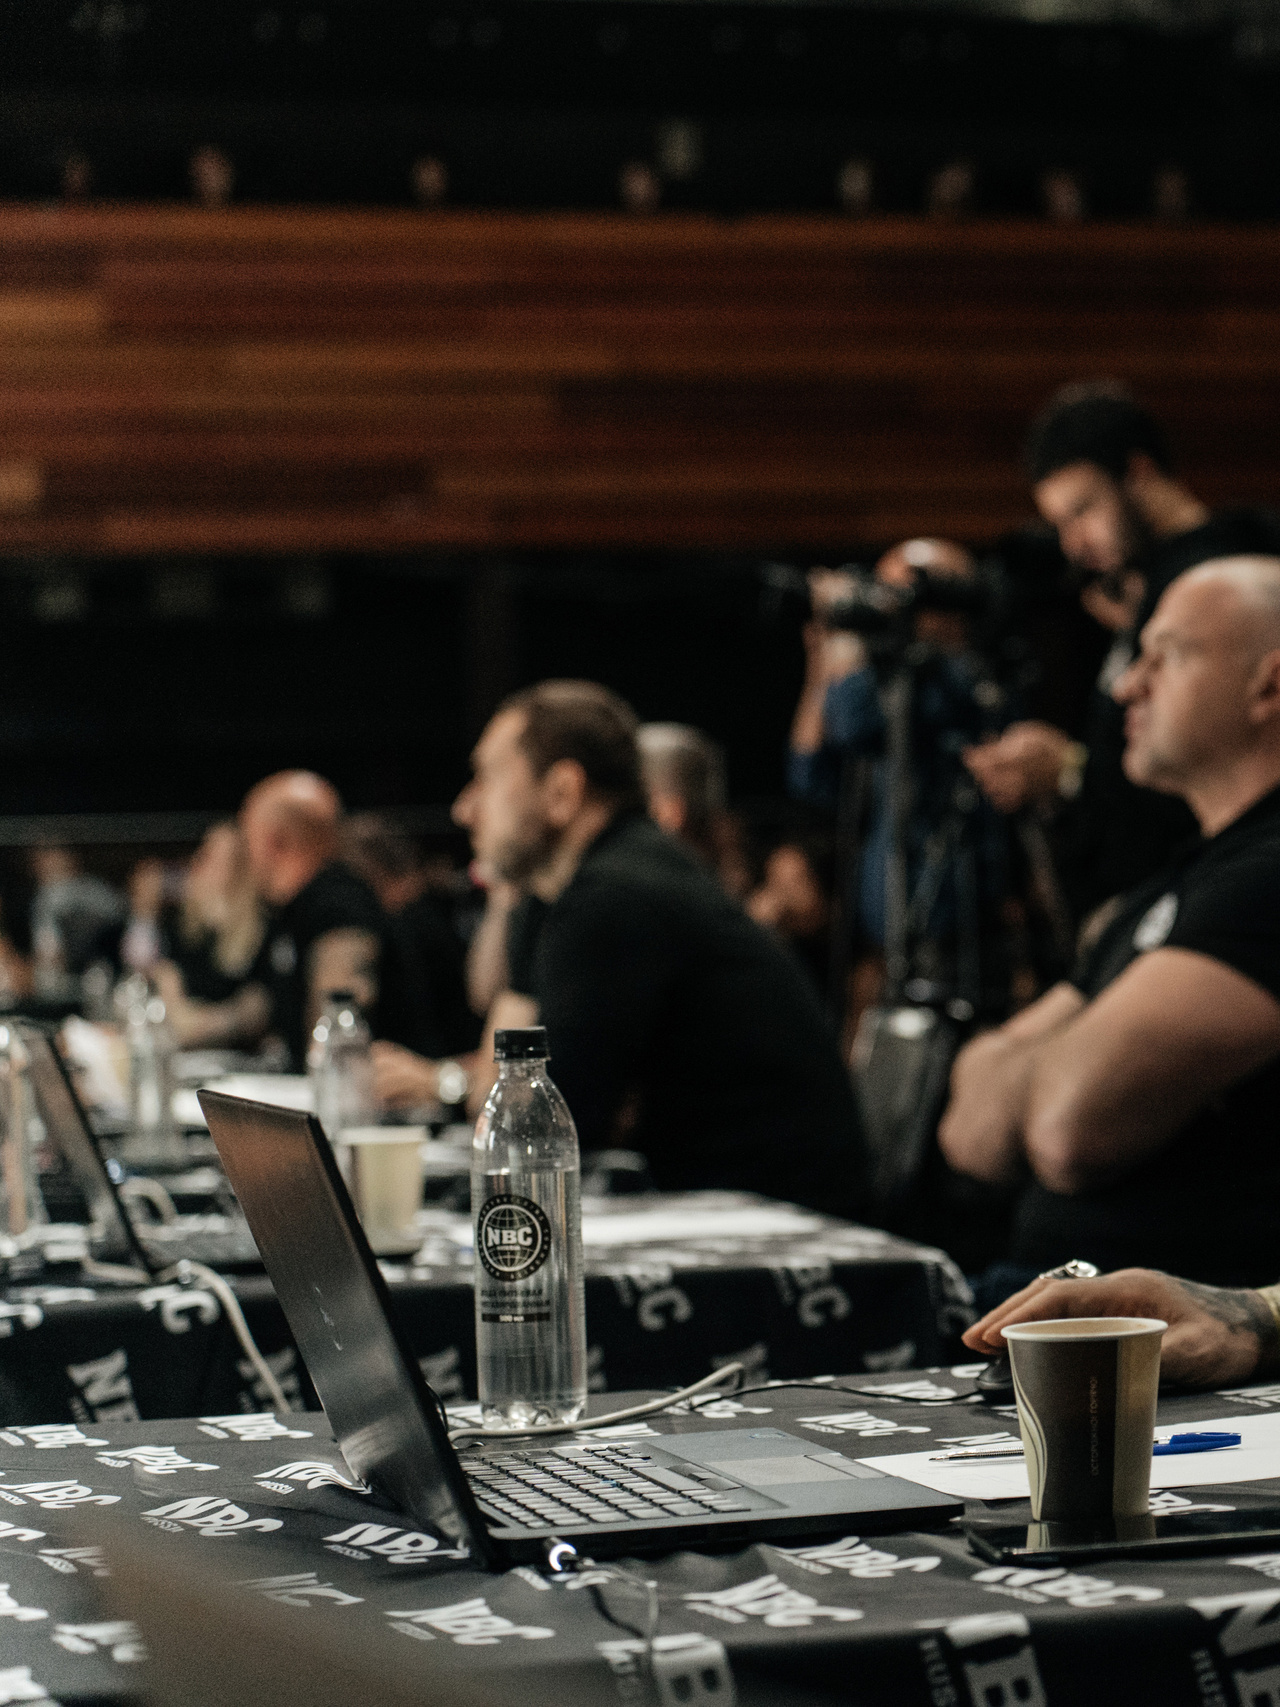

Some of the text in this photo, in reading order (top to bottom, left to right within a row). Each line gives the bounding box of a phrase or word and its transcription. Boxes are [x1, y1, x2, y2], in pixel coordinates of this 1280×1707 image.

[486, 1226, 533, 1247] NBC
[796, 1411, 931, 1437] NBC
[97, 1446, 220, 1474] NBC
[0, 1480, 122, 1509] NBC
[1148, 1490, 1236, 1517] BC
[140, 1496, 284, 1536] NBC
[321, 1522, 470, 1563] NBC
[770, 1536, 941, 1578] NBC
[682, 1574, 865, 1627] NBC
[970, 1566, 1165, 1607] NBC
[384, 1598, 556, 1645] NBC
